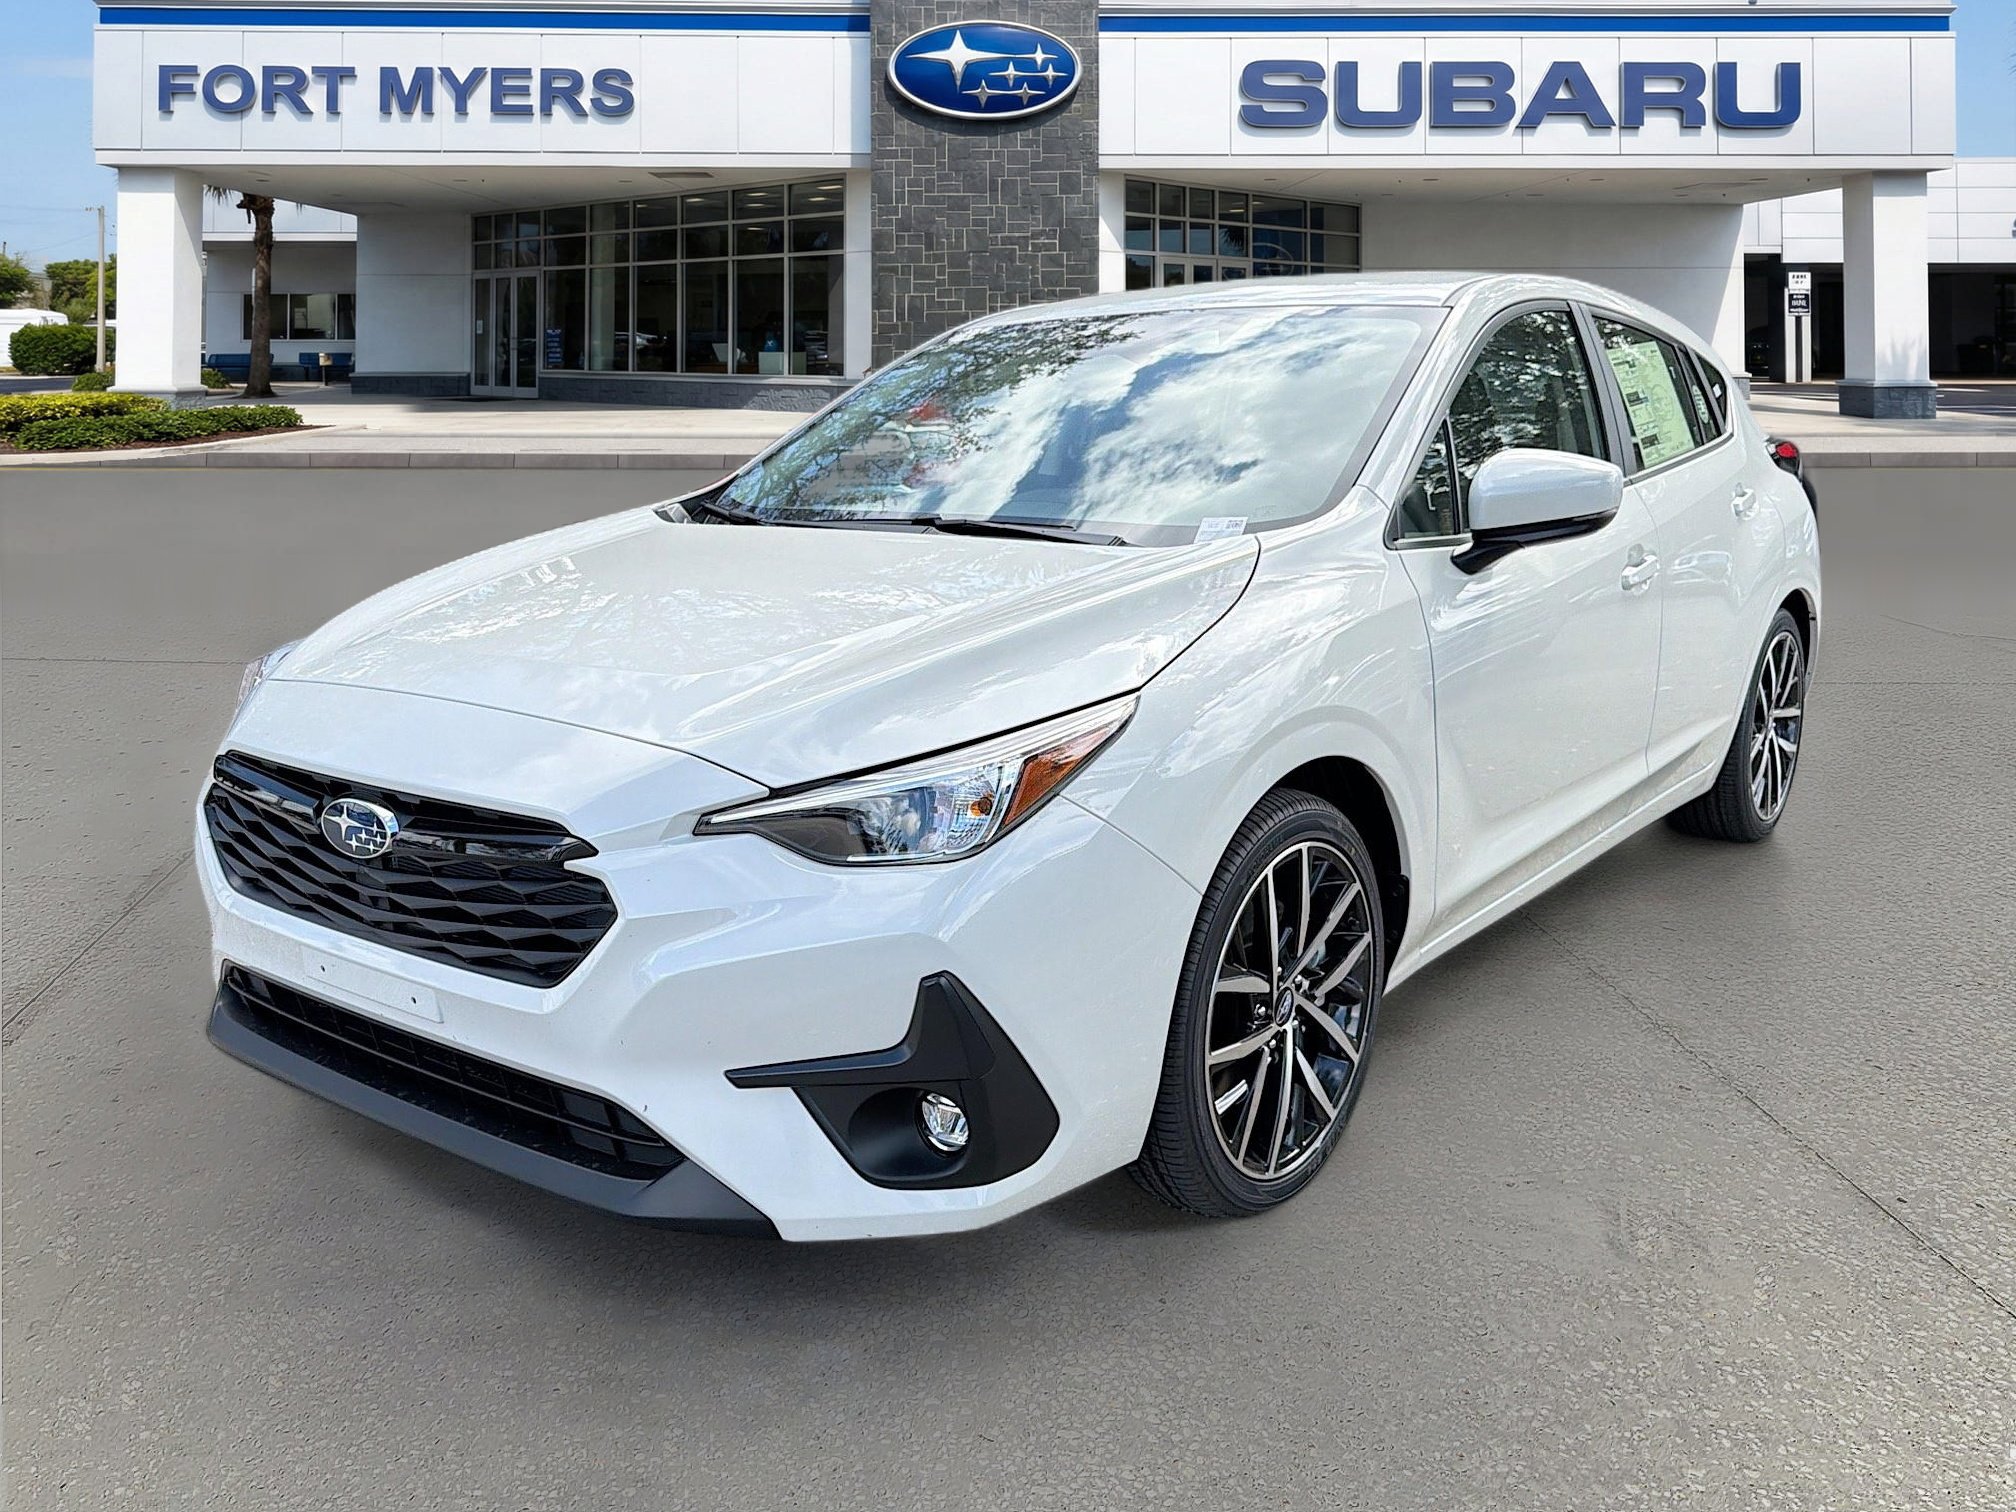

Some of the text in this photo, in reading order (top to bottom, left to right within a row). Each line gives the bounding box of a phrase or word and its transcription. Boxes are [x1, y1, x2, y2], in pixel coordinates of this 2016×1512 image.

[158, 64, 635, 116] FORT MYERS
[1240, 60, 1802, 129] SUBARU
